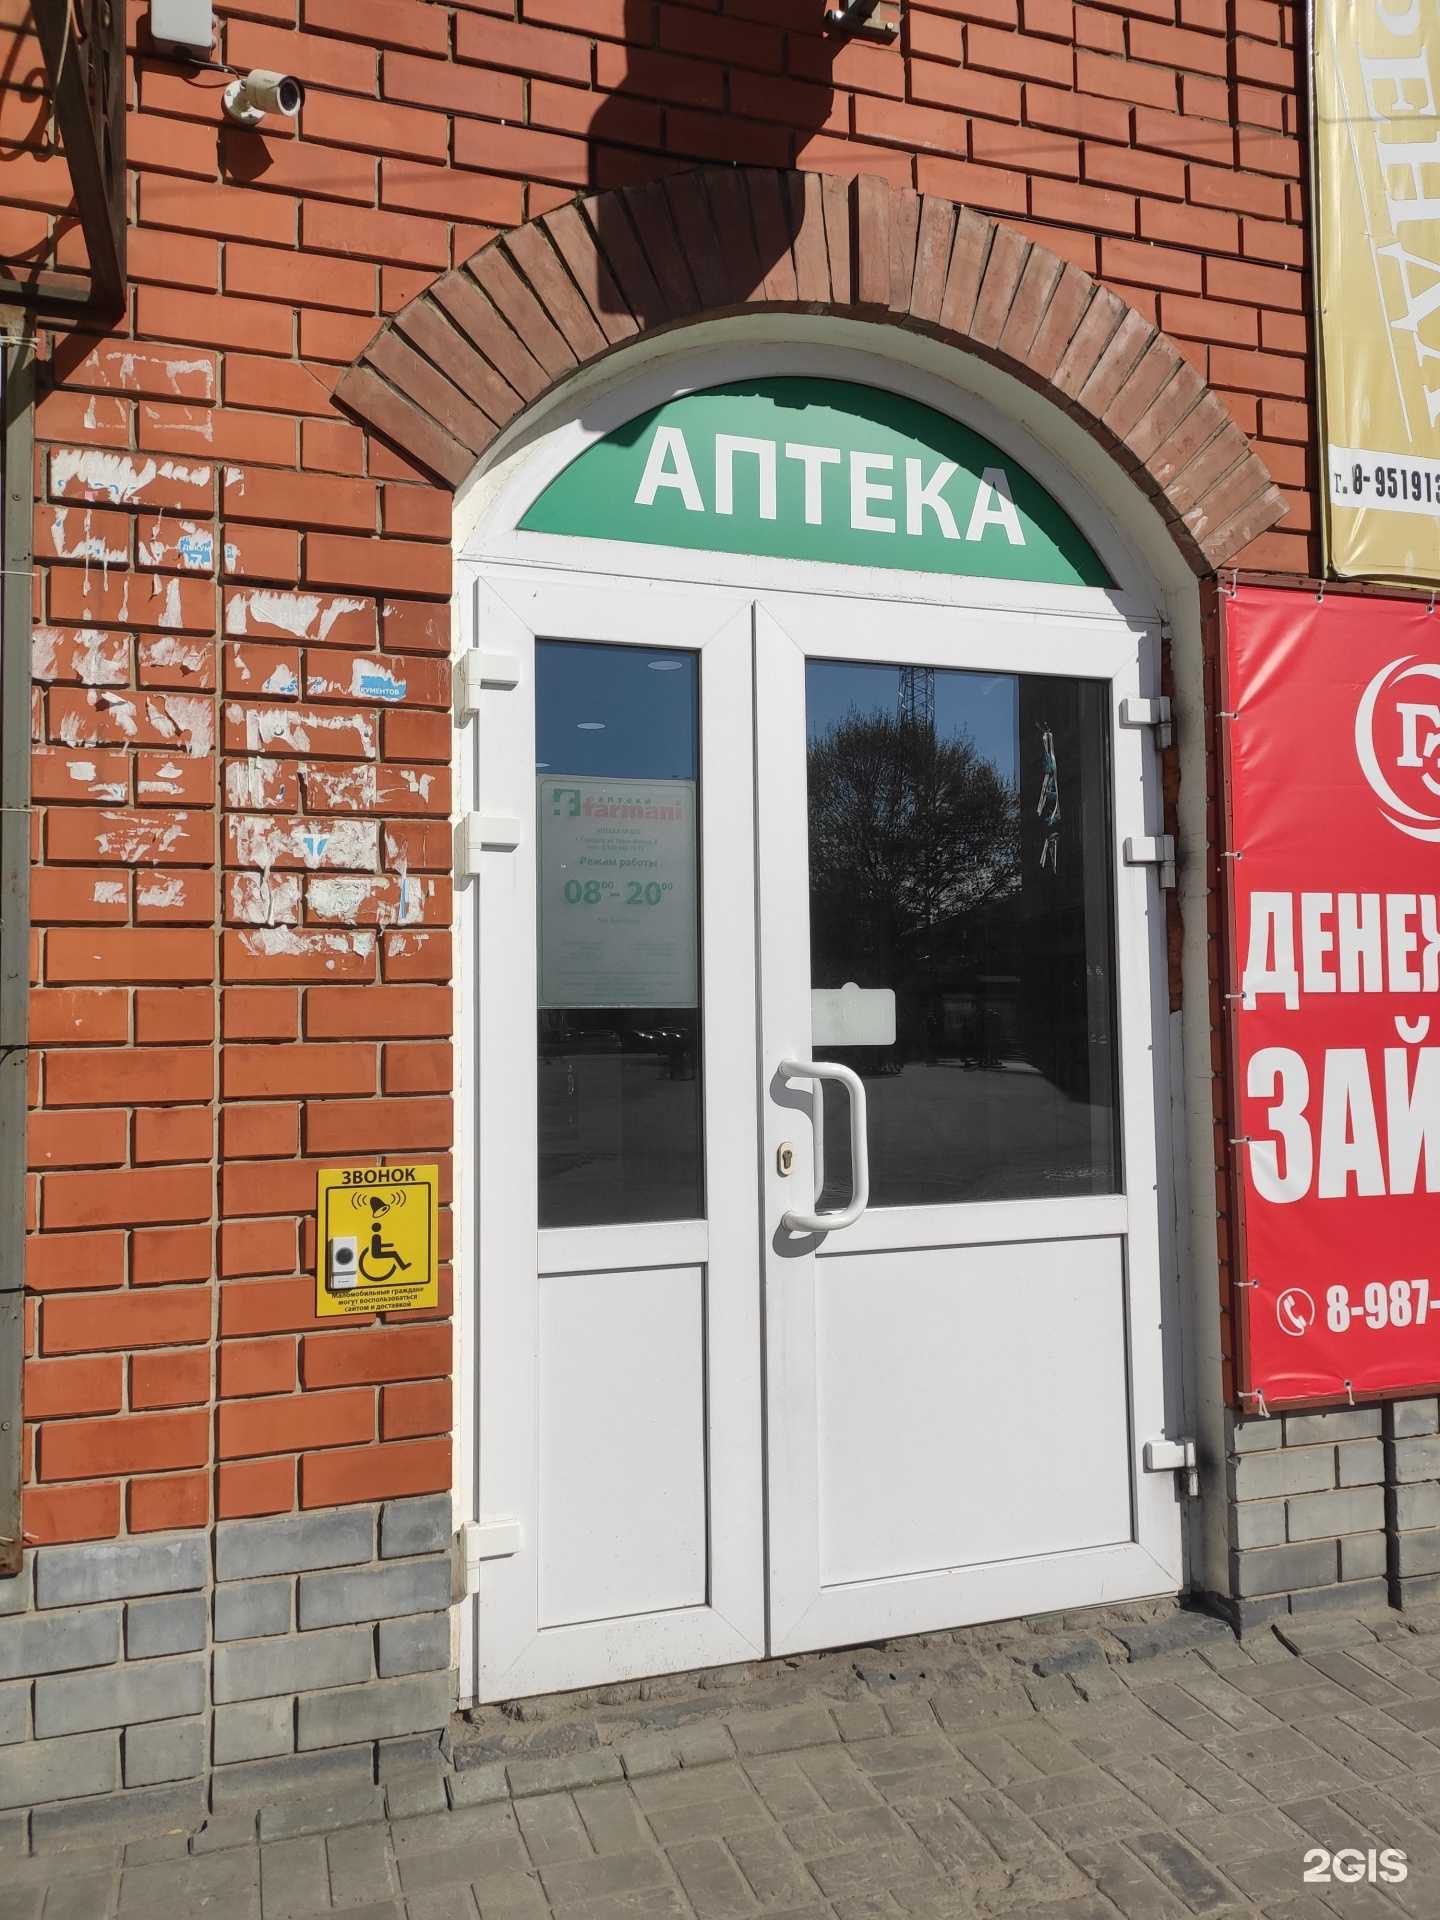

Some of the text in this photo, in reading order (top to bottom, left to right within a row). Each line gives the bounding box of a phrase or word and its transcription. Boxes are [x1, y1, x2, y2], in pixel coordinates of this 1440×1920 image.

[634, 425, 1026, 546] АПТЕКА
[1247, 1015, 1440, 1204] ЗАЙ
[342, 1167, 416, 1185] ЗВОНОК
[1326, 1278, 1440, 1333] 8-987-
